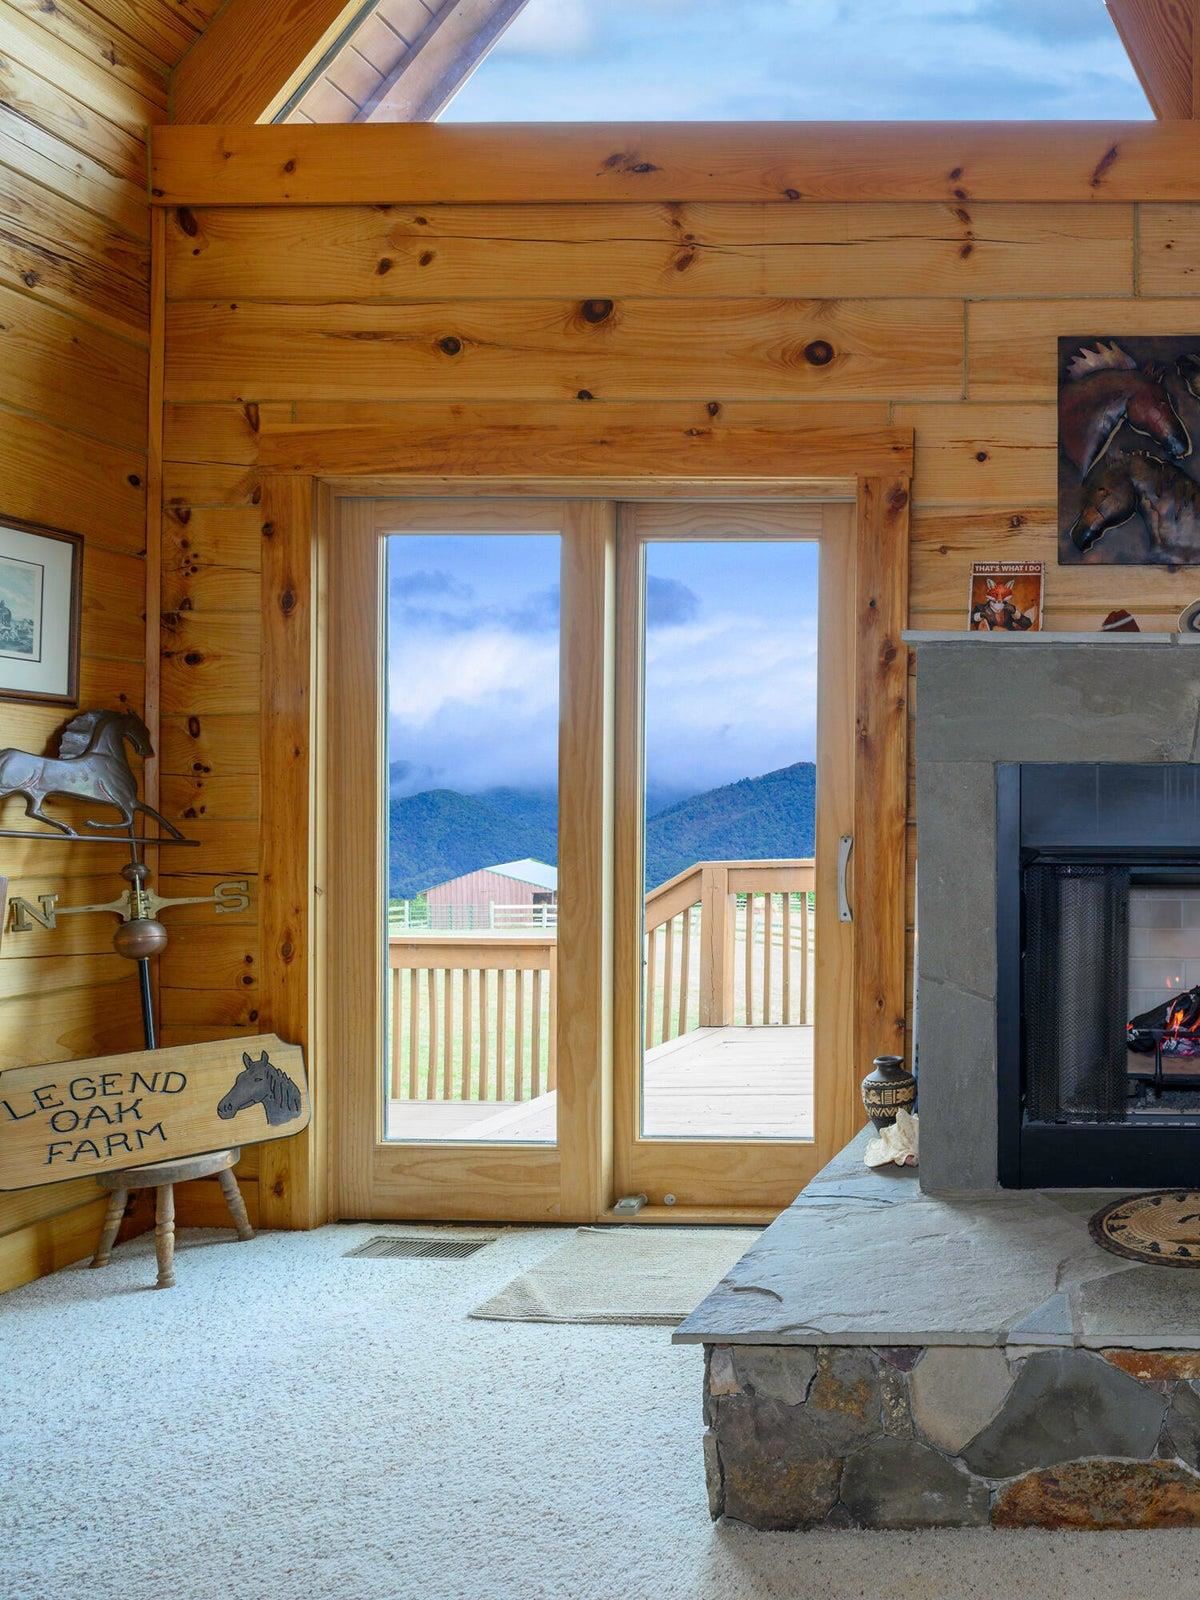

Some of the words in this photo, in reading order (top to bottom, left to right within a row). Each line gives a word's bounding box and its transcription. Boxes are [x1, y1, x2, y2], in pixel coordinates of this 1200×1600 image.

[8, 893, 58, 932] N
[212, 880, 251, 913] S
[1, 1071, 187, 1121] LEGEND
[49, 1098, 143, 1133] OAK
[43, 1121, 168, 1164] FARM
